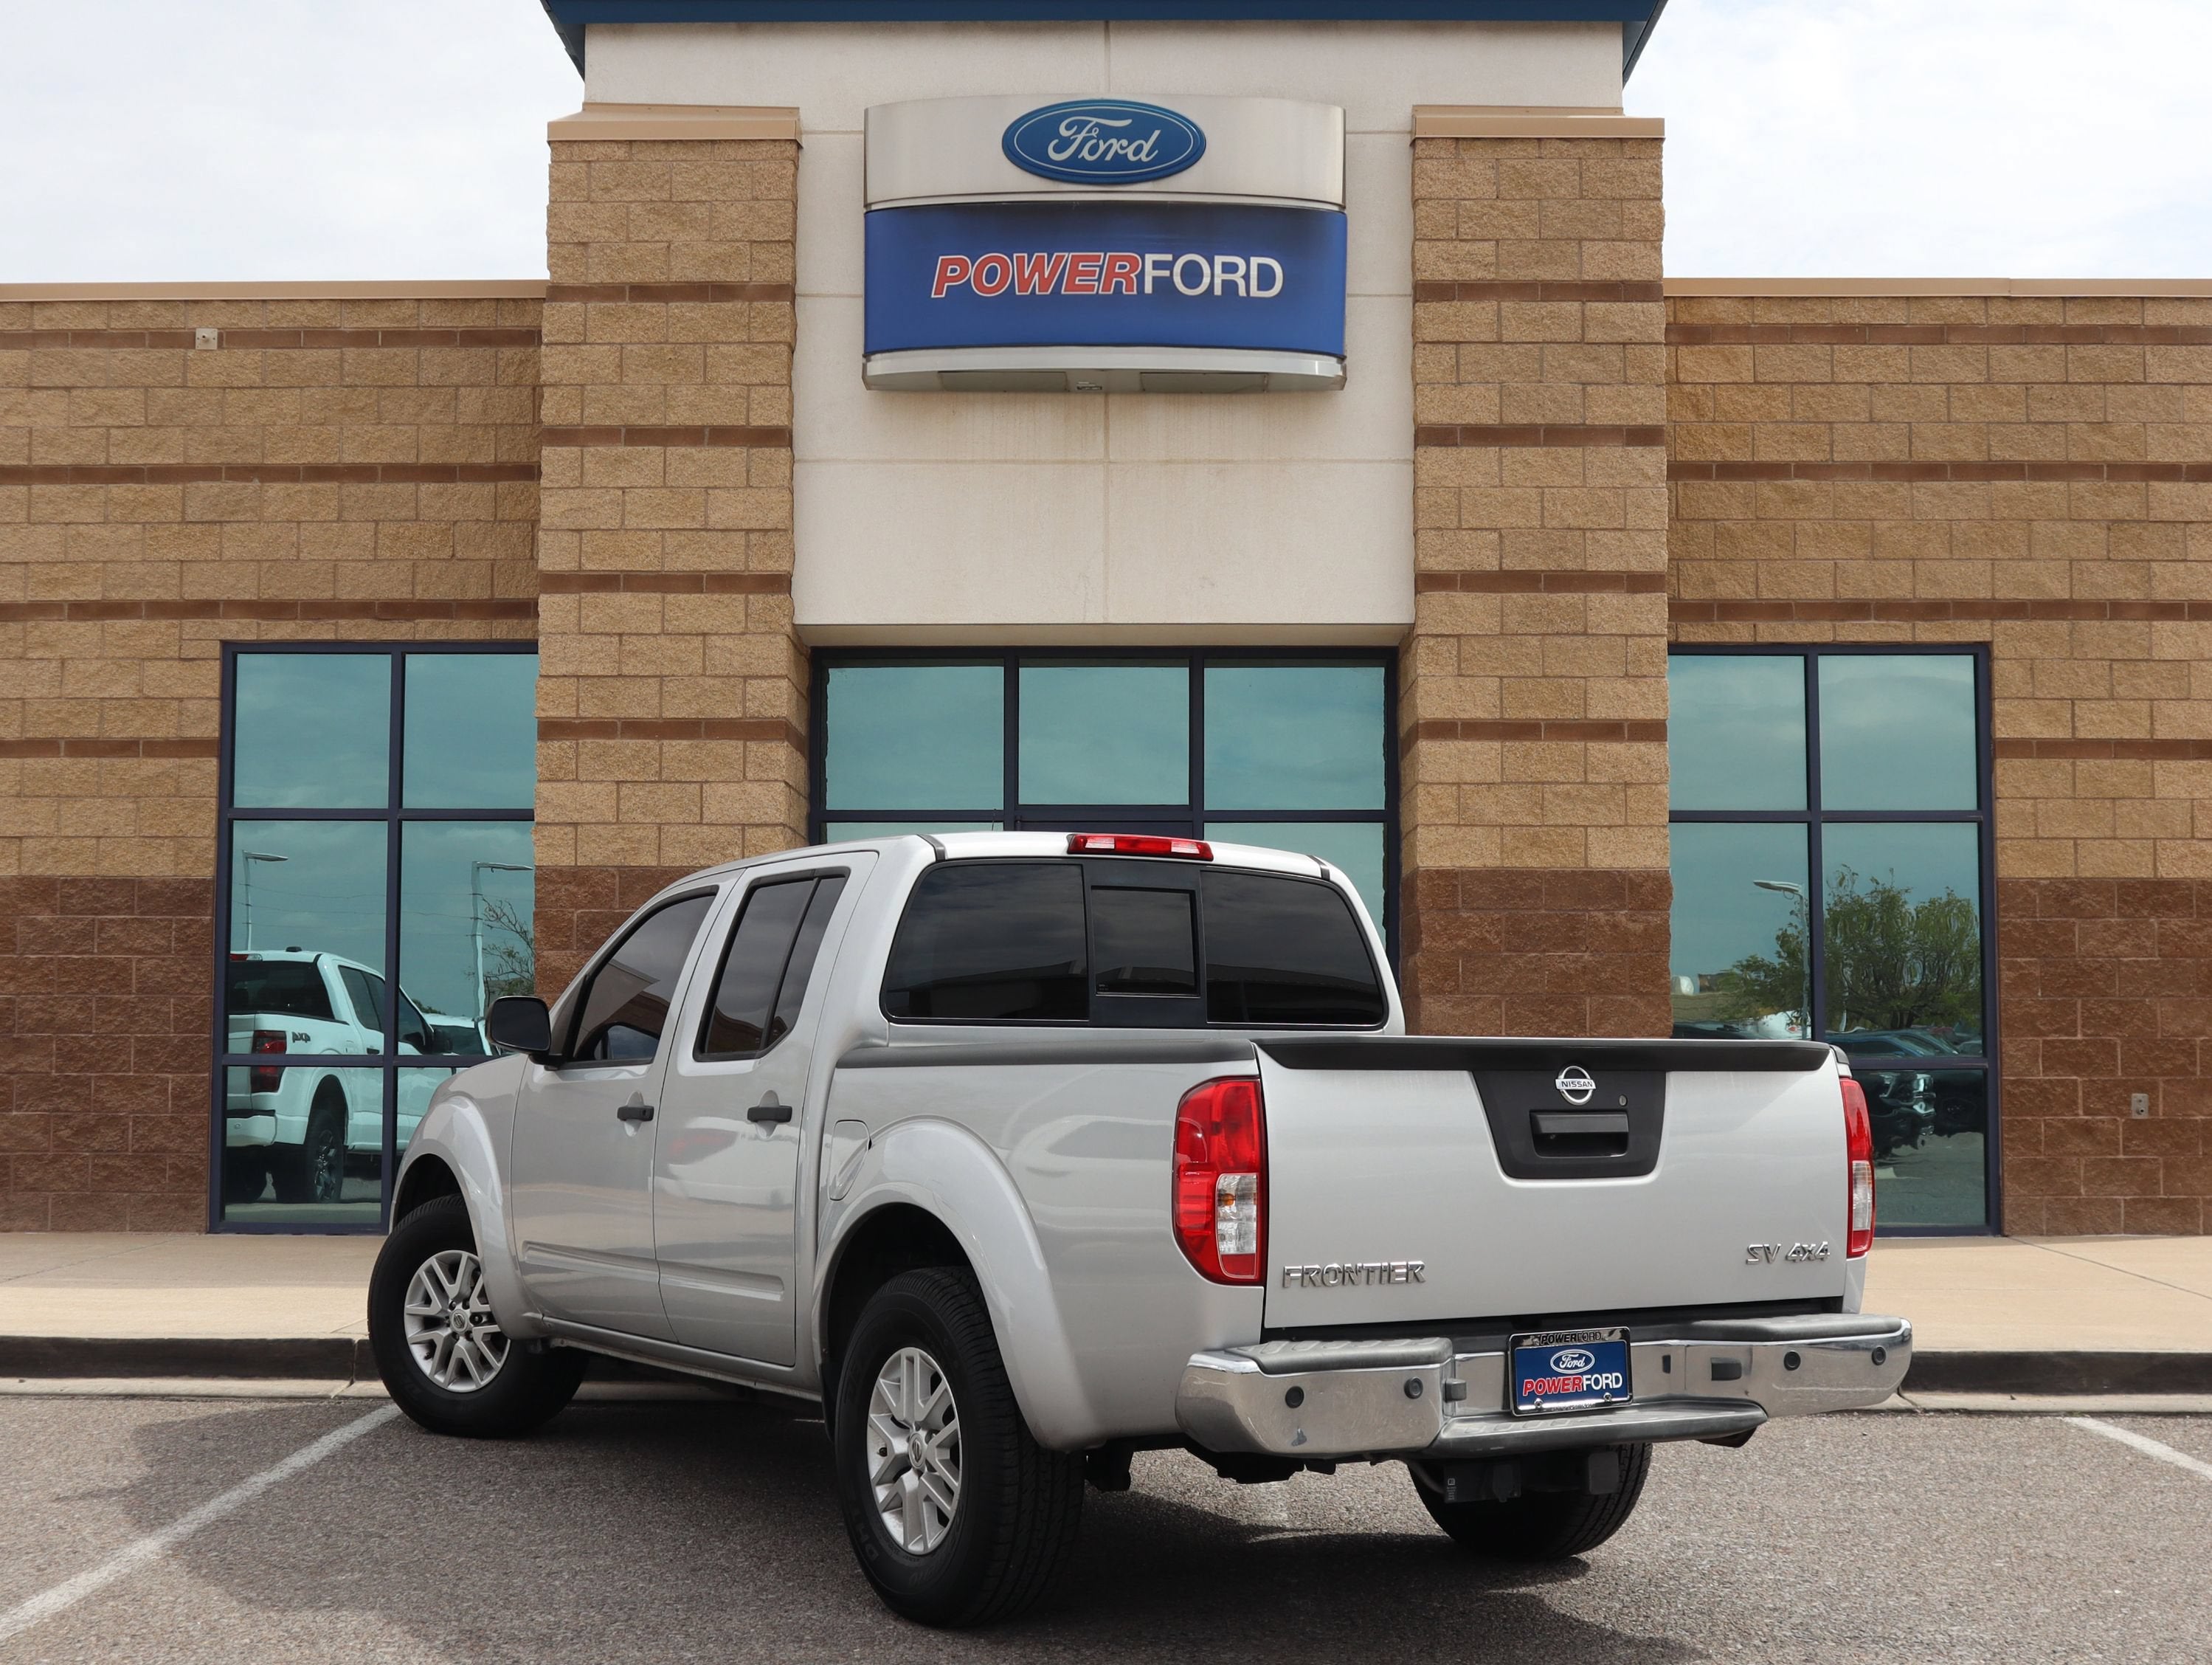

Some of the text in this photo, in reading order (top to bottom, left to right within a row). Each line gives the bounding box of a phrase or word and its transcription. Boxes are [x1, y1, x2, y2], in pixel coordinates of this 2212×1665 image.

[1047, 115, 1161, 162] Ford
[1746, 1243, 1782, 1265] SV
[1282, 1260, 1426, 1289] FRONTIER
[1560, 1354, 1585, 1368] Ford
